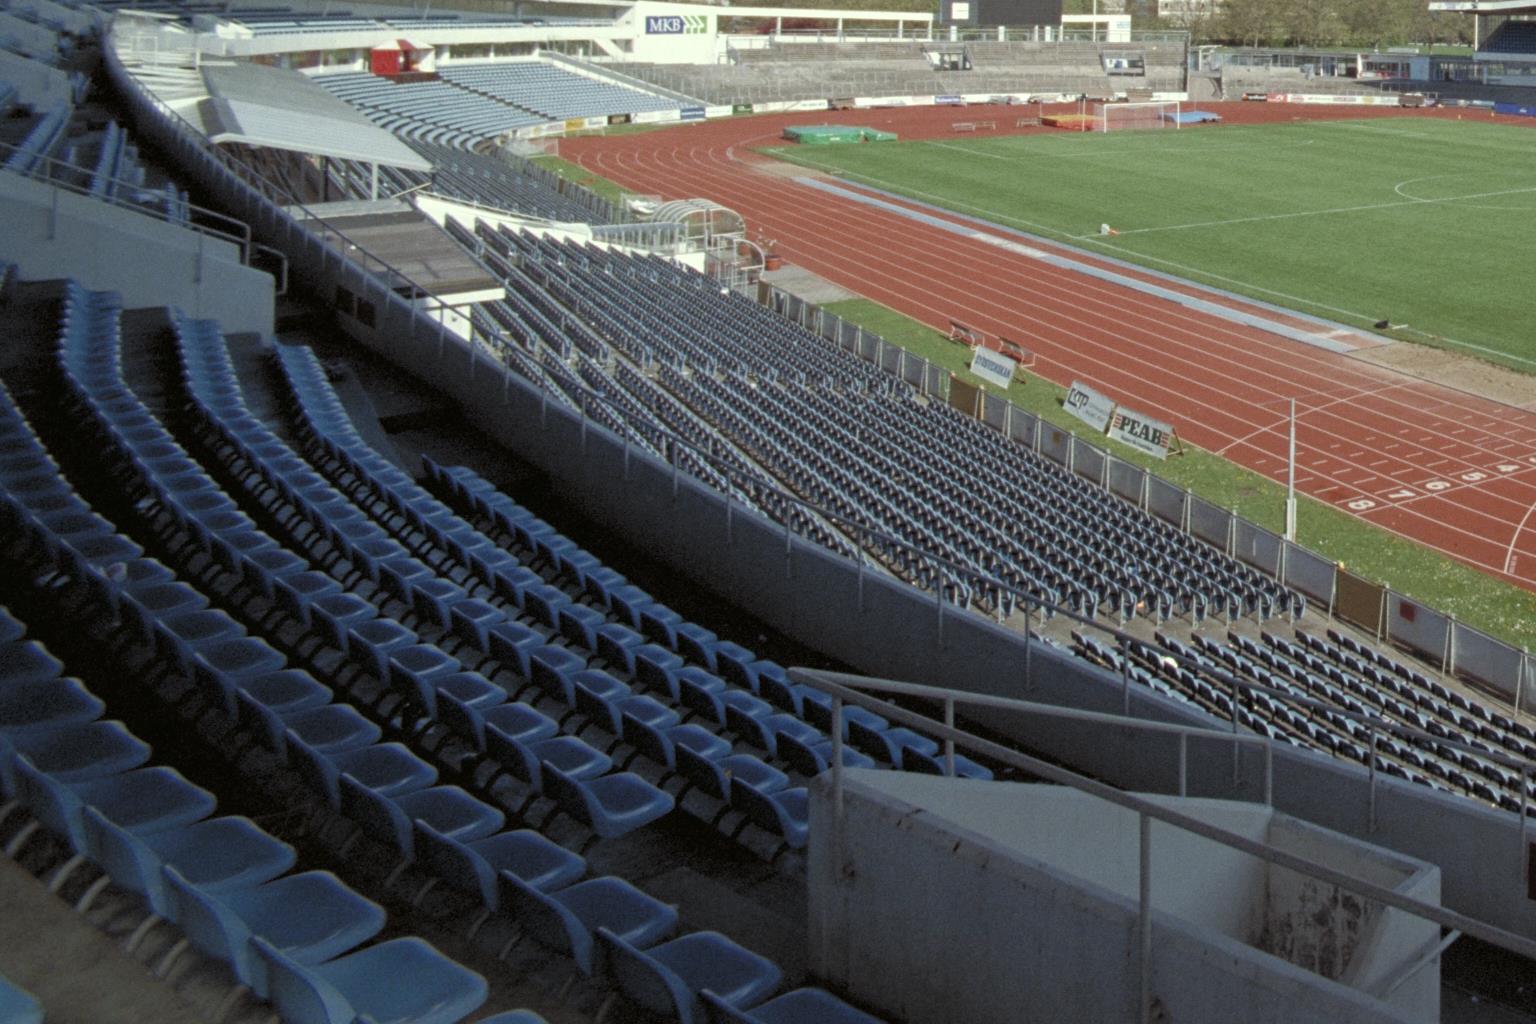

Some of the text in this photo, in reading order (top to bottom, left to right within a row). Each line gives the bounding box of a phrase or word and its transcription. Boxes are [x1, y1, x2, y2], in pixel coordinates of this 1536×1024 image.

[649, 18, 680, 32] MKB
[1119, 416, 1161, 445] PEAB
[1496, 463, 1520, 472] 4
[1461, 472, 1488, 481] 5
[1425, 480, 1451, 490] 6
[1388, 490, 1416, 499] 7
[1348, 499, 1376, 510] 8
